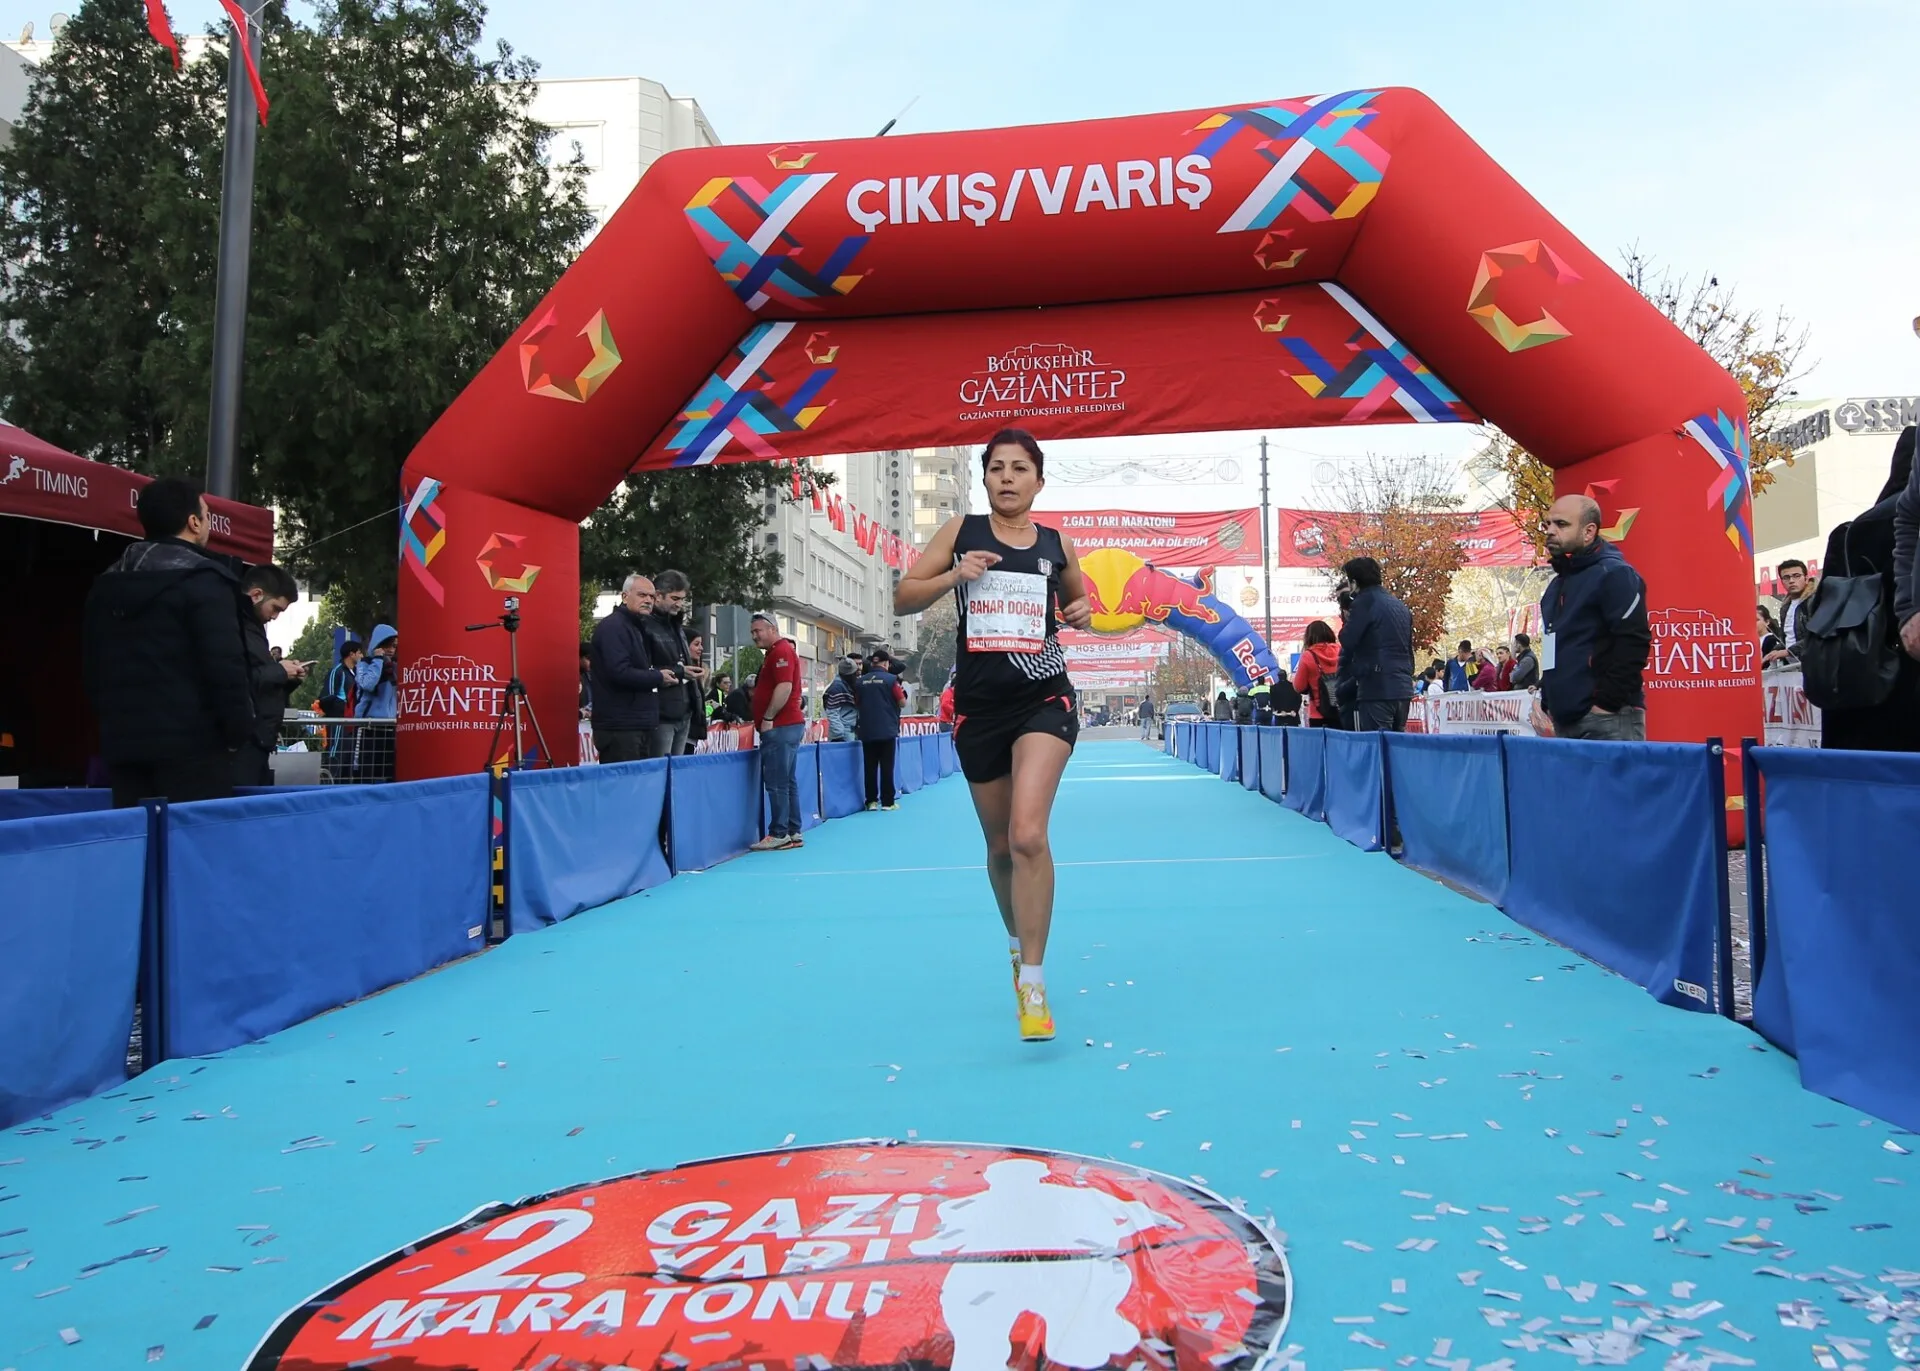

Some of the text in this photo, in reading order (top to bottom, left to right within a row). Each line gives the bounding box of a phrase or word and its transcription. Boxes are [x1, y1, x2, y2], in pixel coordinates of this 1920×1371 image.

[846, 154, 1212, 232] ÇIKIŞ/VARIŞ
[959, 409, 1012, 421] GAZİANTEP
[1074, 401, 1126, 414] BELEDİYESİ
[32, 467, 88, 498] TIMING
[1096, 515, 1119, 527] YARI
[1121, 516, 1176, 527] MARATONU
[1106, 537, 1165, 549] BAŞARILAR
[1165, 535, 1209, 548] DİLERİM
[969, 598, 1044, 617] BAHAR DOĞAN
[1272, 595, 1302, 604] AZİLER
[1030, 619, 1041, 628] 43
[1649, 618, 1735, 641] ÜKŞEHİR
[999, 639, 1030, 650] MARATONU
[1232, 638, 1269, 680] Red
[1643, 639, 1755, 675] İANTEP
[1718, 676, 1756, 688] BELEDİYESİ
[397, 683, 524, 718] AZİANTE
[473, 721, 527, 731] BELEDİYSİ
[419, 1208, 594, 1294] 2.
[650, 1238, 891, 1280] YARI
[336, 1280, 891, 1340] MARATONU
